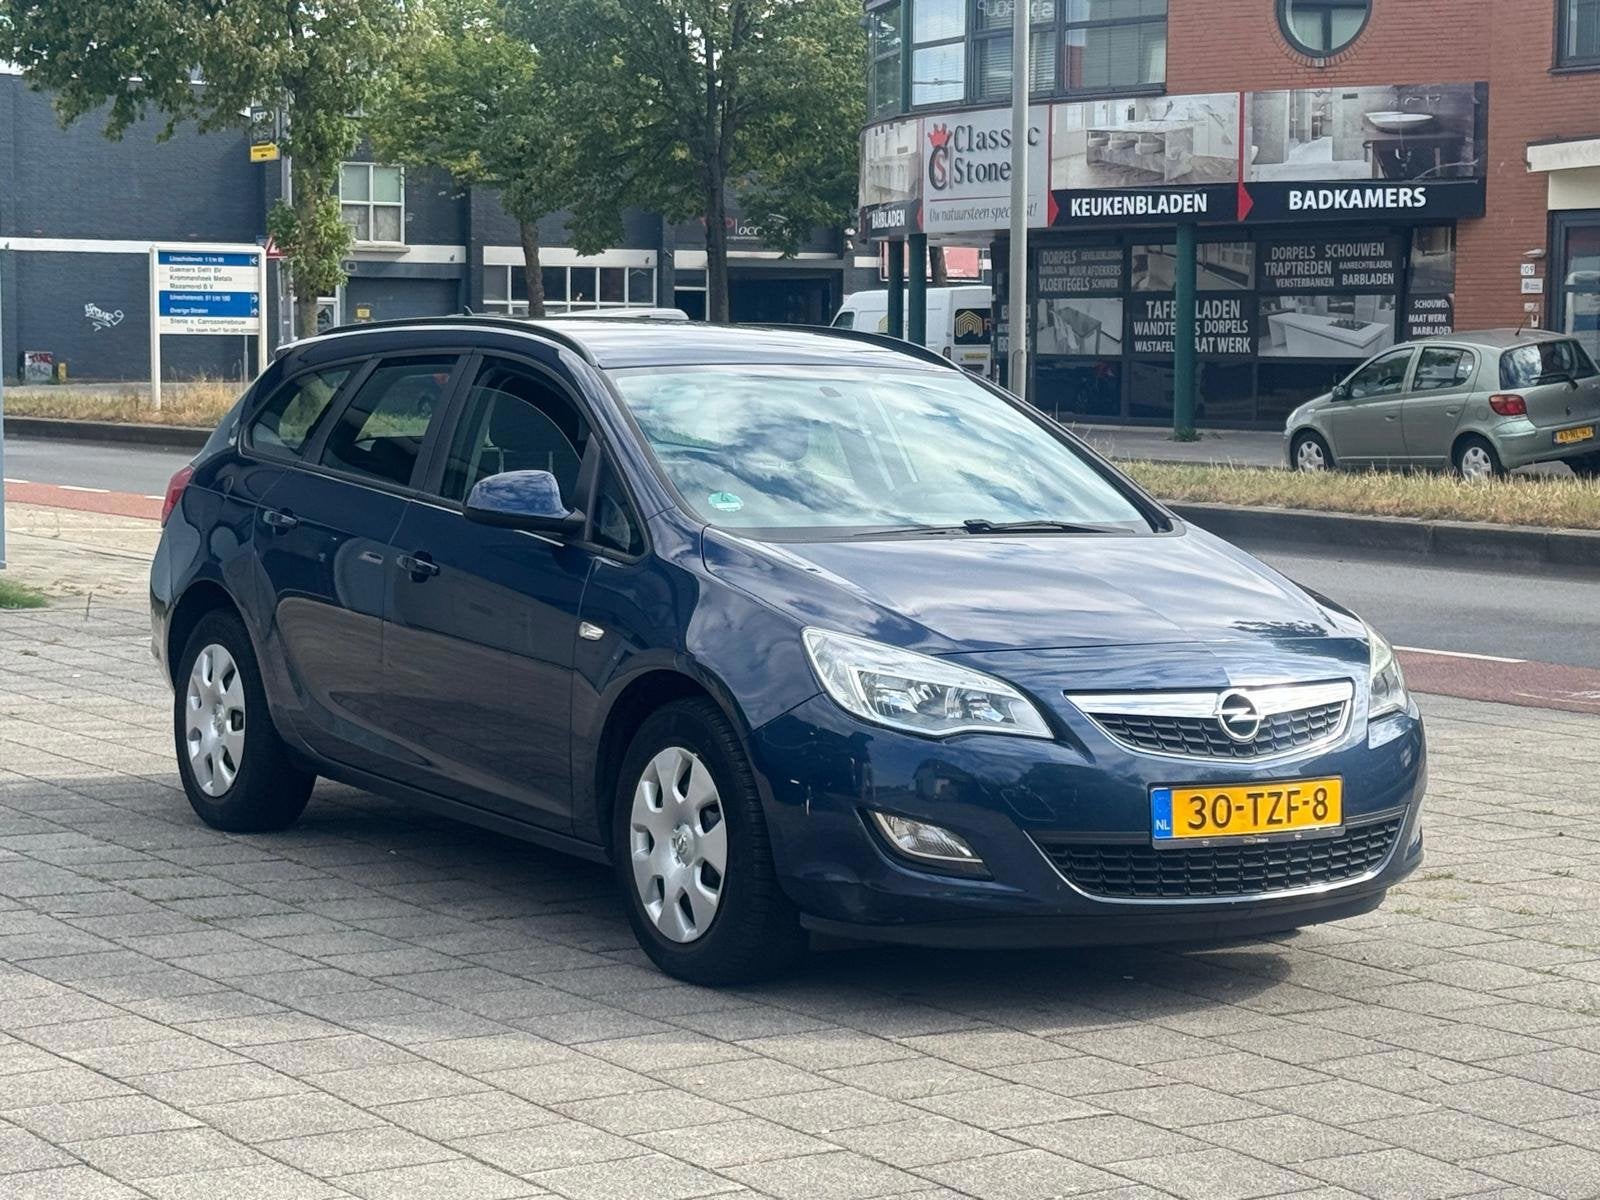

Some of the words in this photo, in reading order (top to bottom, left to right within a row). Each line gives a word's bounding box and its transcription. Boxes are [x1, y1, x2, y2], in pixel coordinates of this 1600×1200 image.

[954, 125, 1041, 154] Classc
[954, 157, 1012, 185] Stone
[1071, 193, 1208, 217] KEUKENBLADEN
[1289, 187, 1427, 211] BADKAMERS
[941, 206, 990, 222] natuursteen
[990, 202, 1038, 222] specst!
[1042, 250, 1077, 265] DORPELS
[1271, 246, 1316, 260] DORPELS
[1325, 243, 1385, 258] SCHOUWEN
[1264, 261, 1332, 276] TRAPTREDEN
[1039, 277, 1090, 292] VLOERTEGELS
[1276, 278, 1335, 288] VENSTERBANKEN
[1342, 273, 1395, 286] BARBLADEN
[1146, 299, 1241, 319] TAFELADEN
[1409, 314, 1427, 323] MAAT
[1427, 313, 1447, 323] WERK
[1133, 321, 1201, 336] WANDTES
[1204, 320, 1249, 334] DORPELS
[1134, 341, 1176, 353] WASTAFEL
[1194, 338, 1215, 353] AAT
[1216, 337, 1251, 353] WERK
[1187, 787, 1329, 830] 30-TZF-8
[1155, 819, 1171, 832] NL
